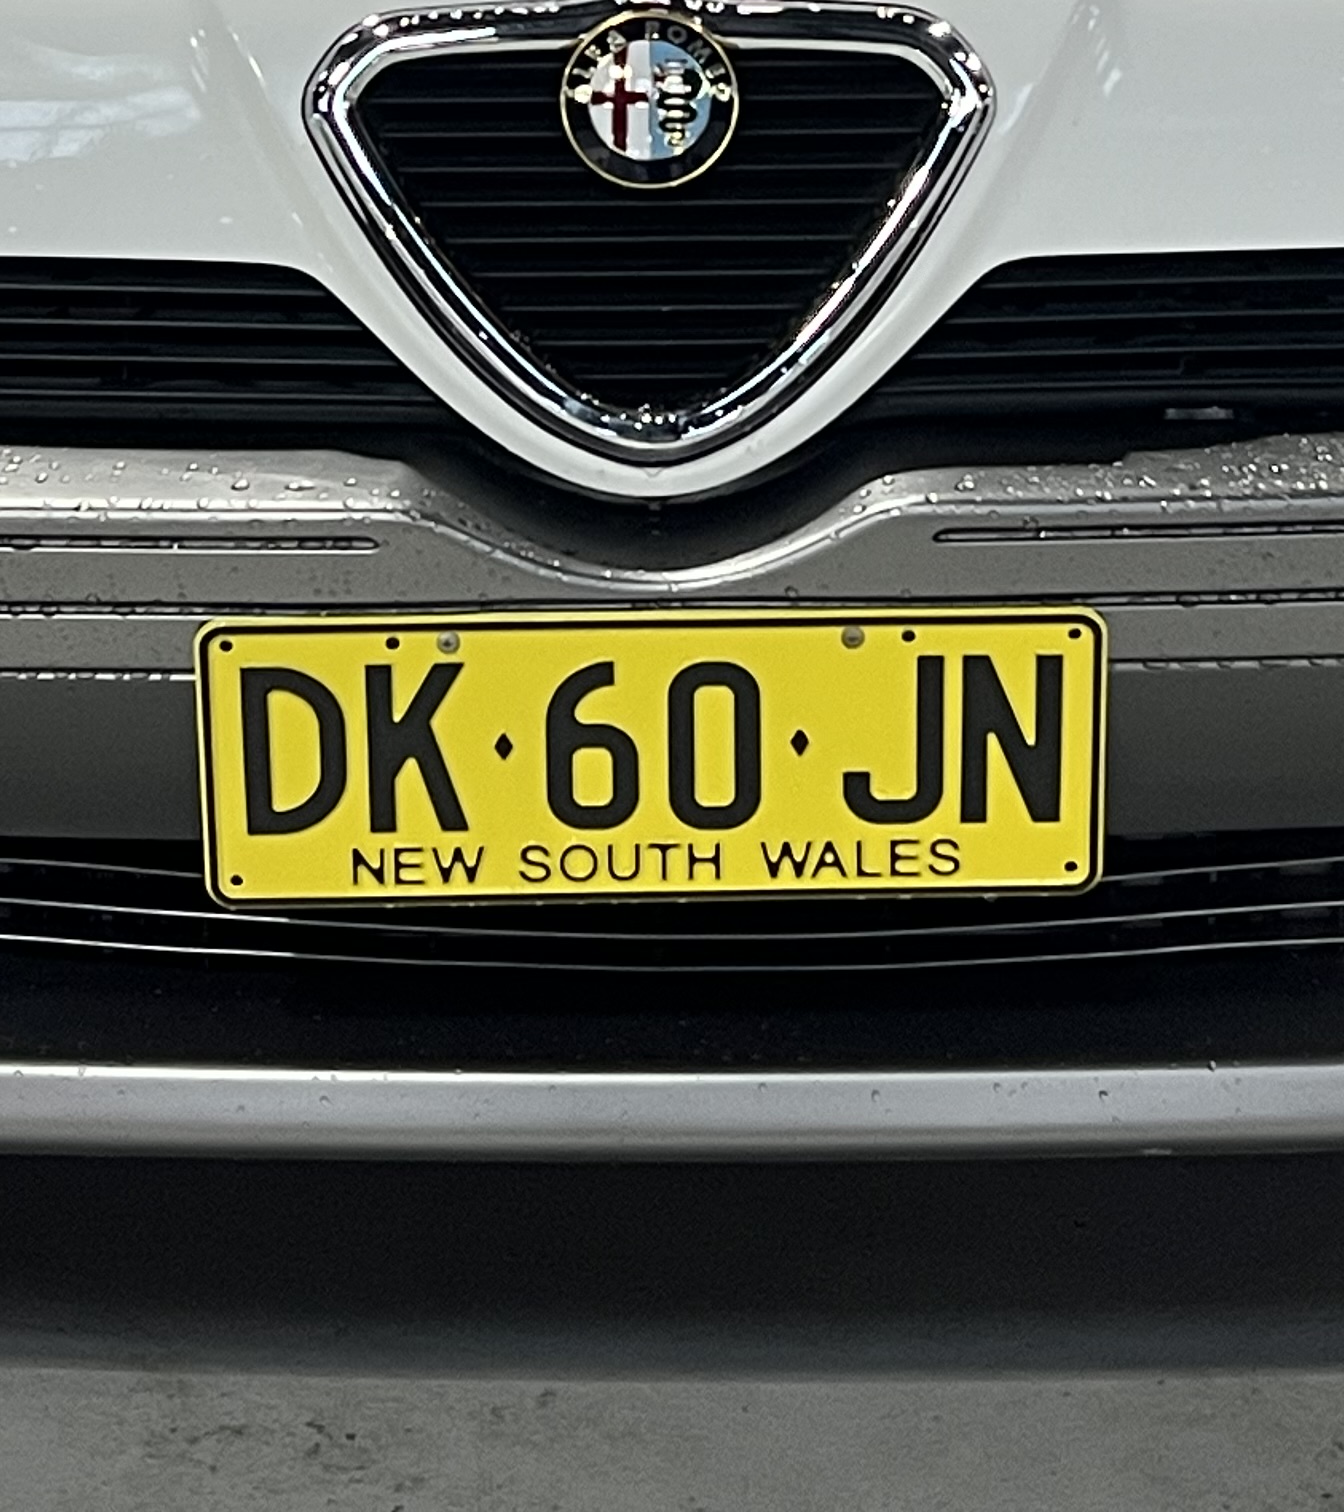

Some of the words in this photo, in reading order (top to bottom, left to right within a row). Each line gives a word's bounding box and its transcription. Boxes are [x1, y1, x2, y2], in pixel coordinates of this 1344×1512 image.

[352, 846, 485, 885] NEW
[519, 842, 721, 883] SOUTH
[760, 838, 961, 878] WALES
